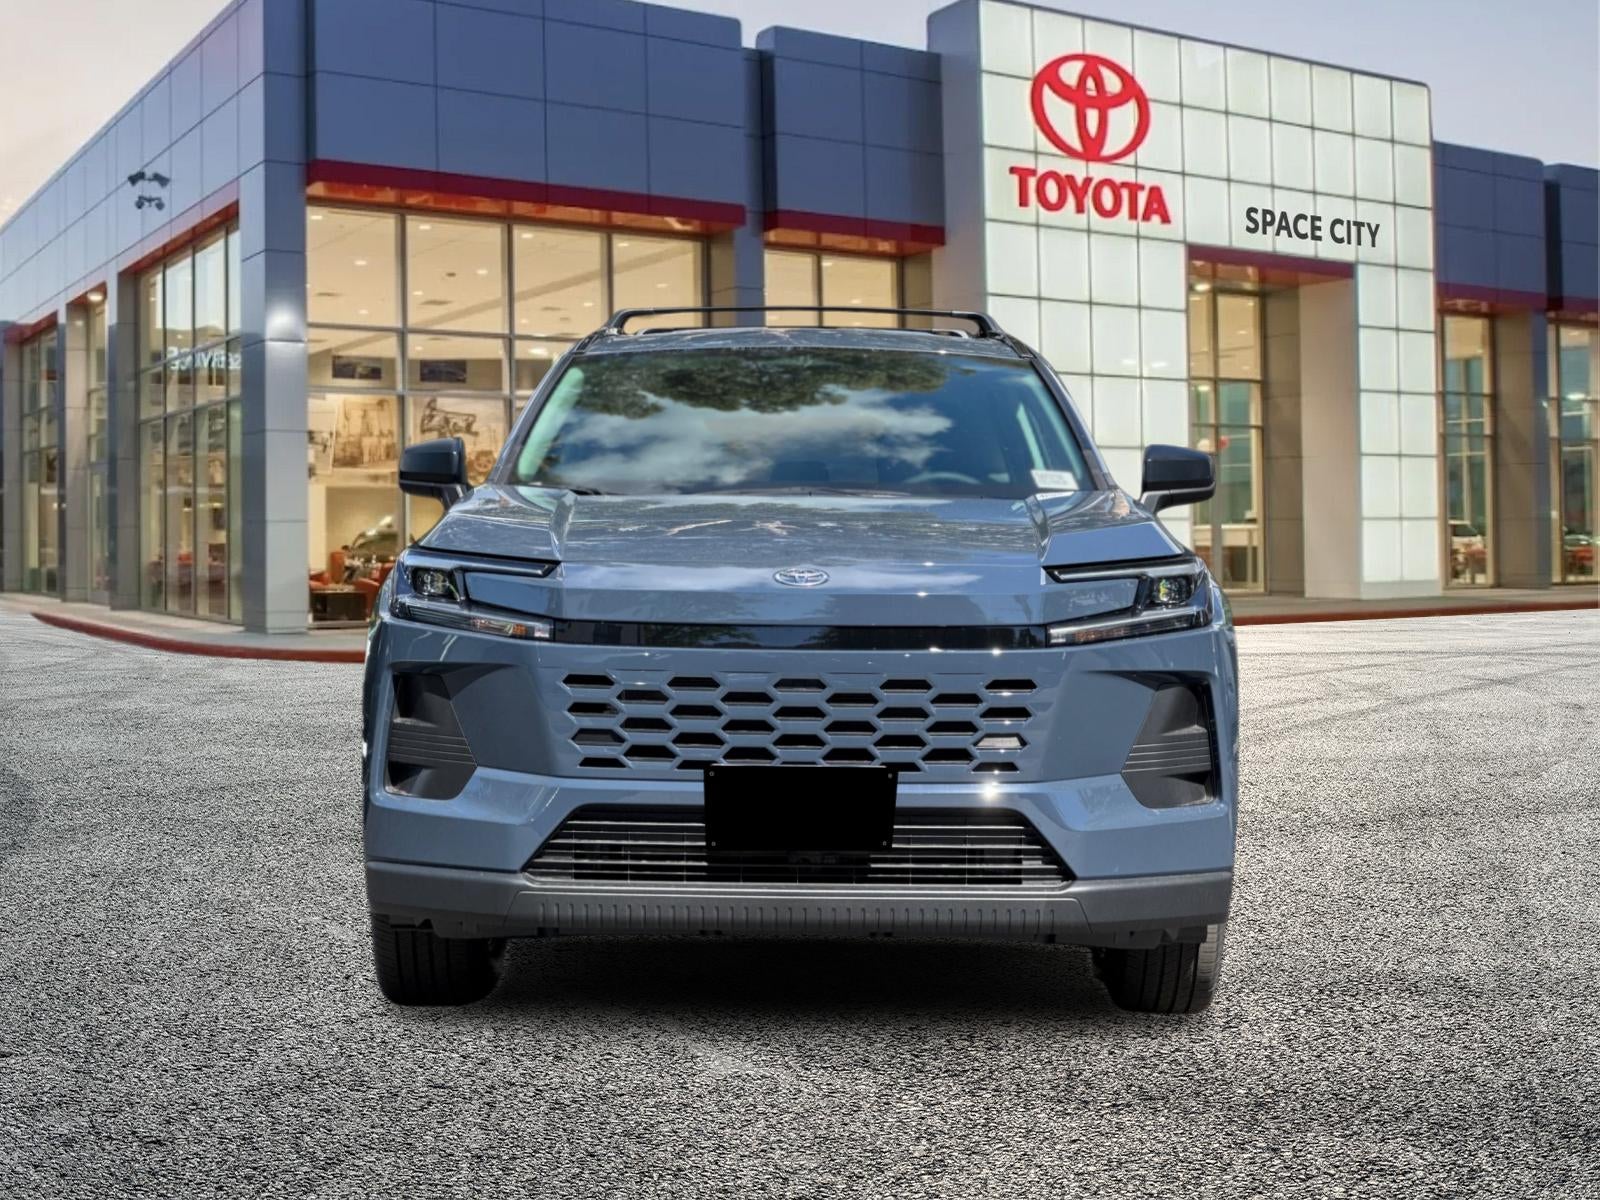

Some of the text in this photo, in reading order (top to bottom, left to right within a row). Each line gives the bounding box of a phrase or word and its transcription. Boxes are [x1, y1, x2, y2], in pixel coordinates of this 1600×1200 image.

[1009, 166, 1171, 224] TOYOTA
[1245, 206, 1381, 248] SPACE CITY
